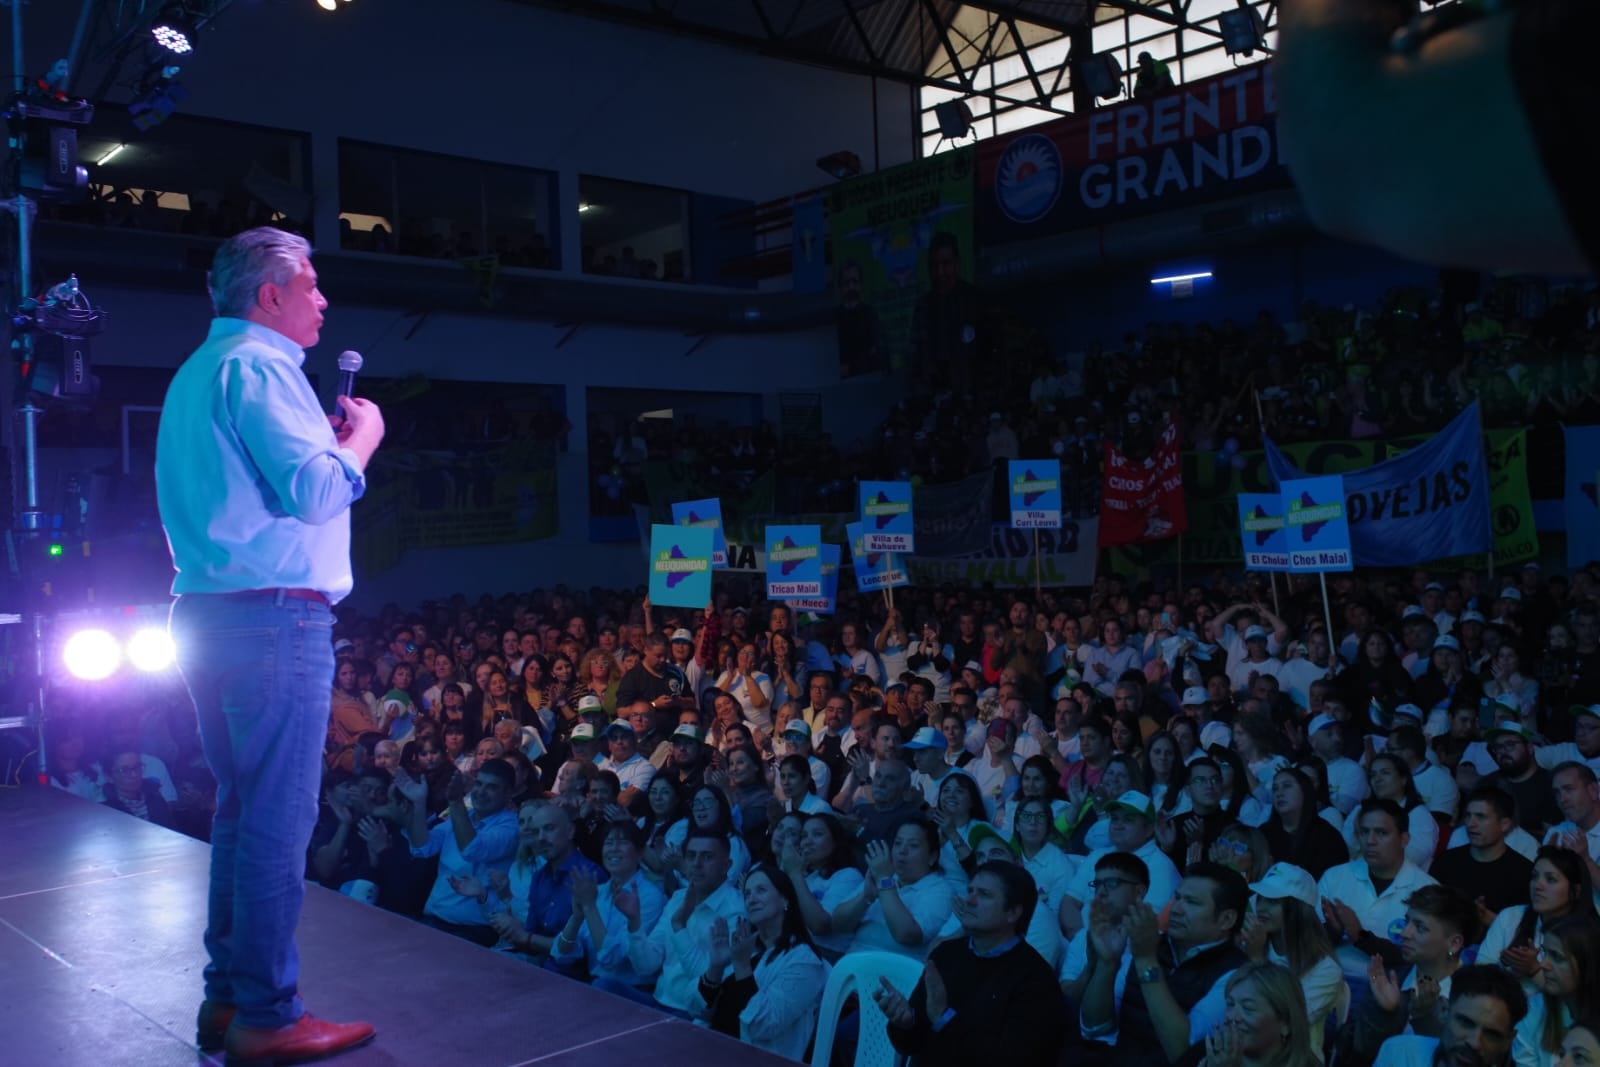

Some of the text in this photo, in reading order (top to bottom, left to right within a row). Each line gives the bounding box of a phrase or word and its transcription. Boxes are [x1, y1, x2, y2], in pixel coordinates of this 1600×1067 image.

[1346, 462, 1468, 525] OVEJAS
[872, 535, 905, 543] Villa de
[871, 542, 908, 550] Nahueve
[1251, 555, 1260, 565] El
[1293, 553, 1347, 566] Chos Malal
[770, 584, 819, 594] Tricao Malal
